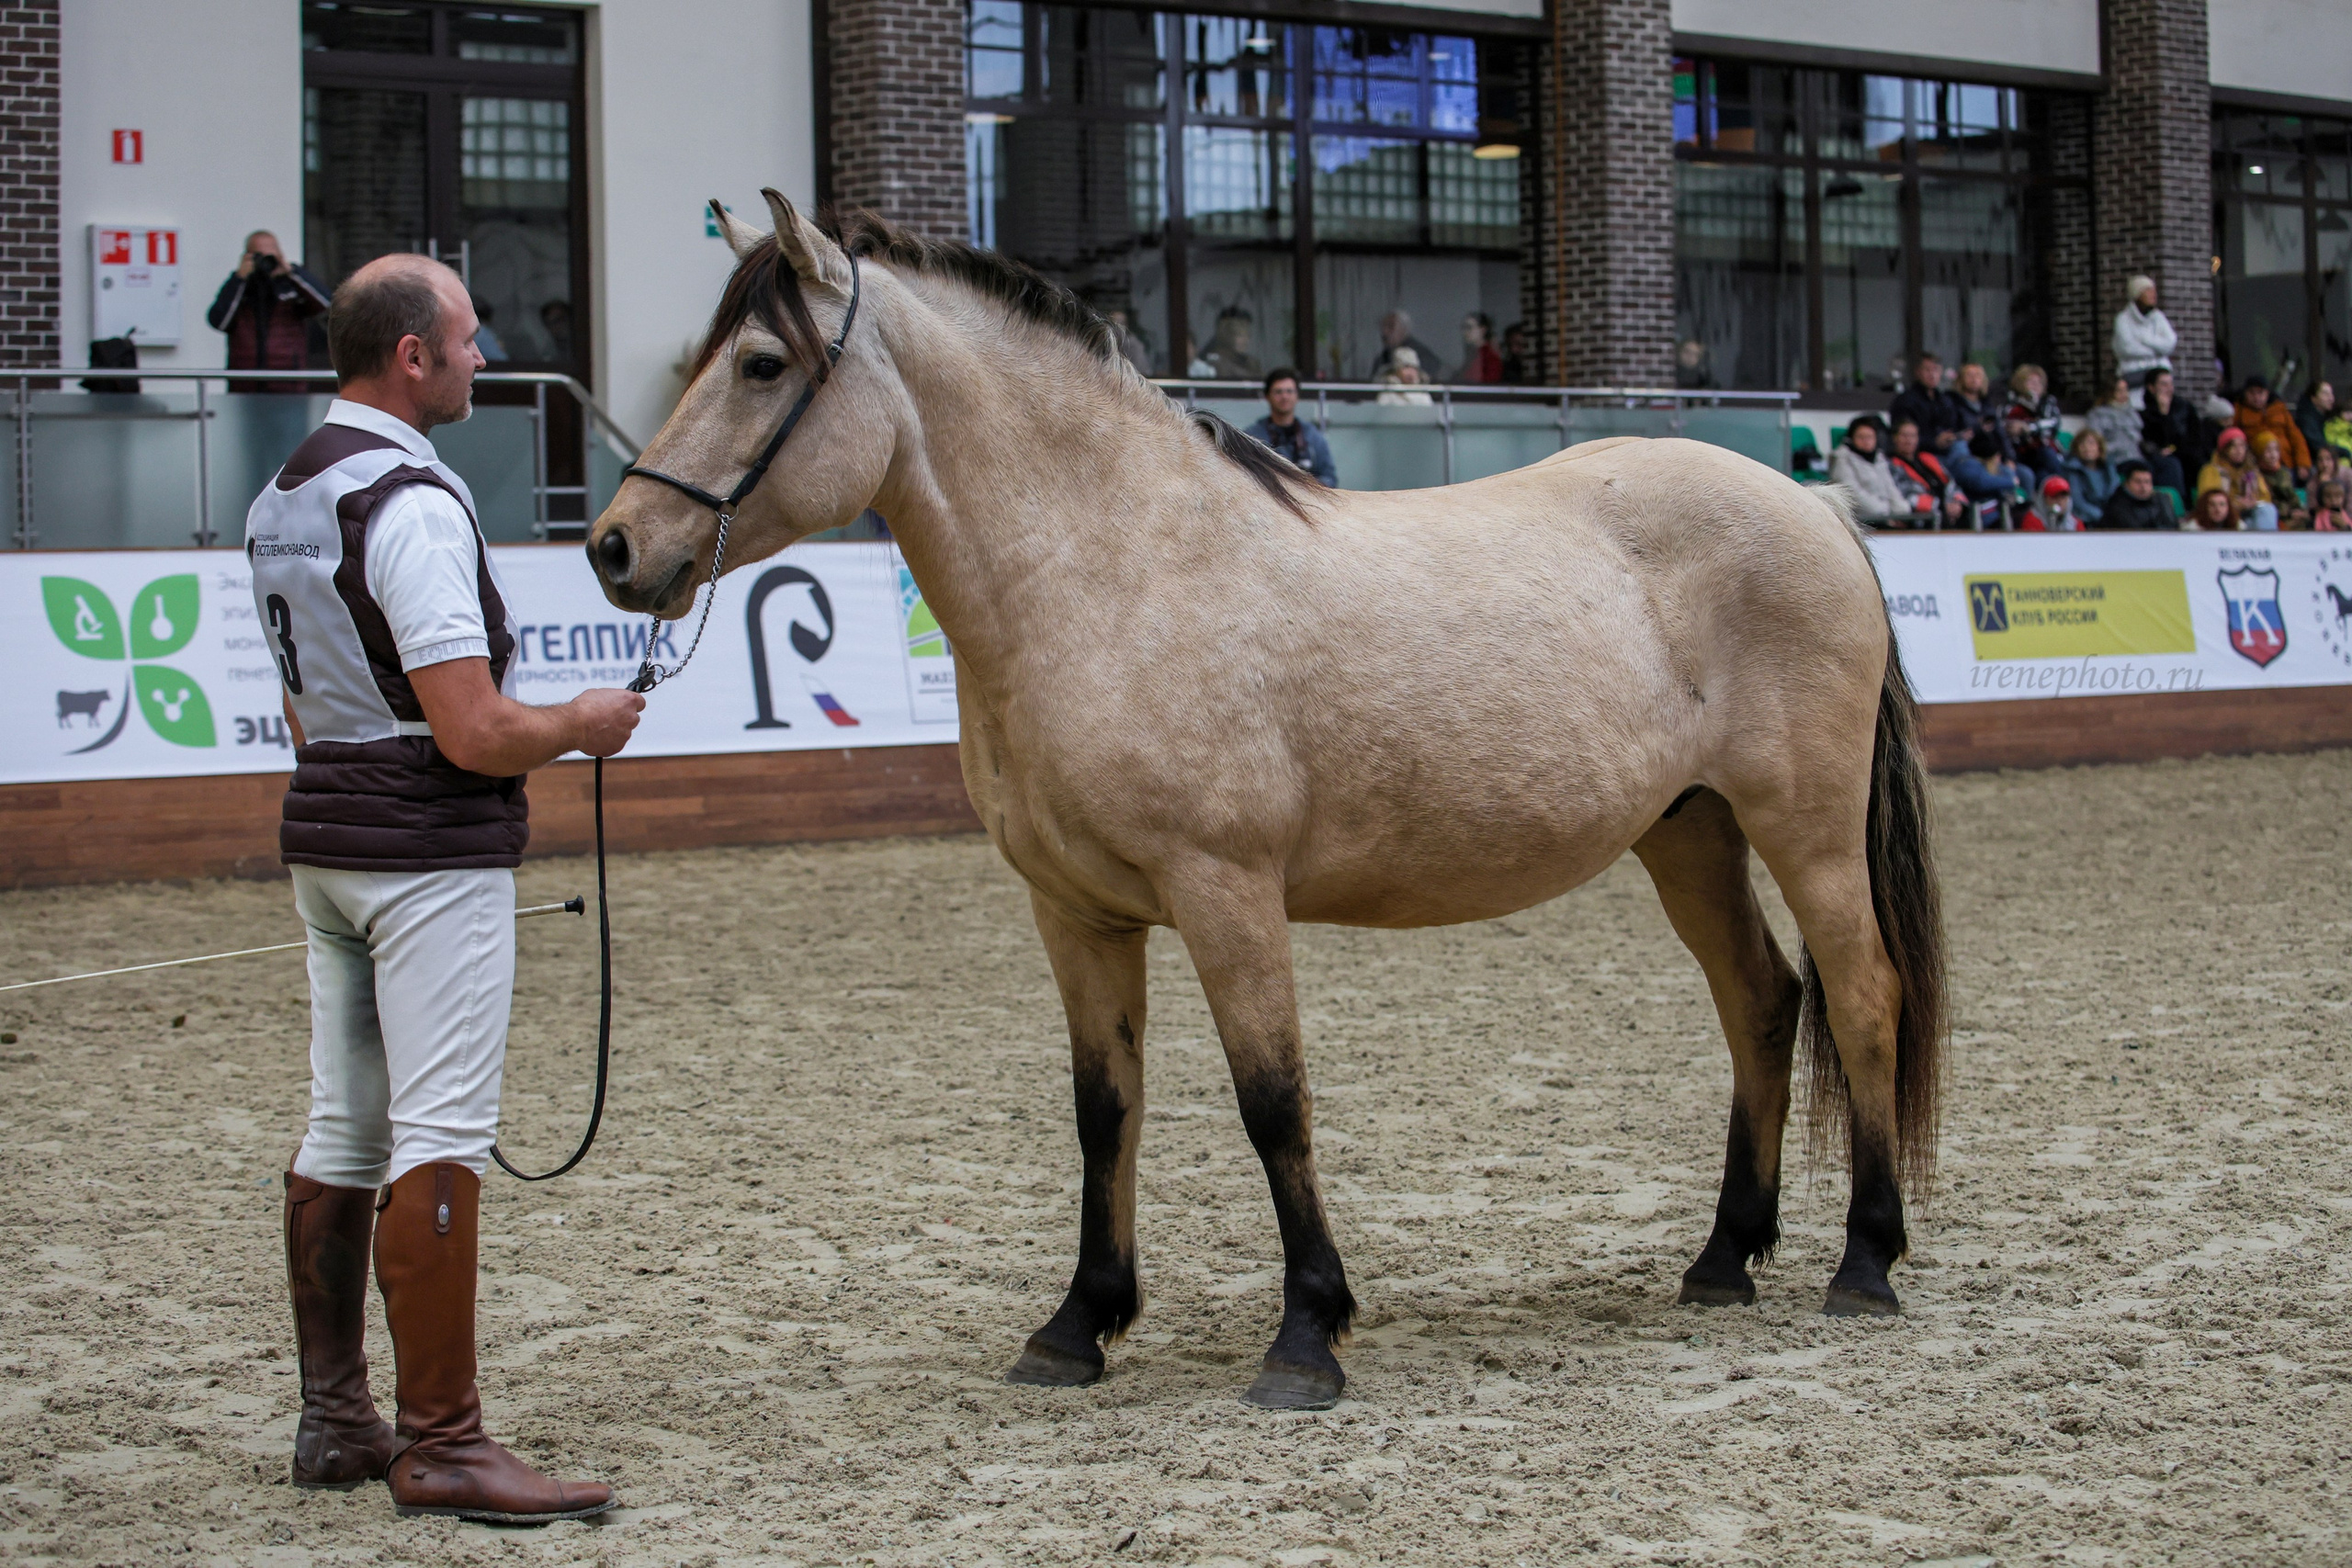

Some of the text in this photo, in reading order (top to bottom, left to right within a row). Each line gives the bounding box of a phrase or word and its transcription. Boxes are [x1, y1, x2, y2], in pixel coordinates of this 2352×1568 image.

[266, 592, 303, 695] 3
[2012, 607, 2098, 626] КЛУБ РОССИИ
